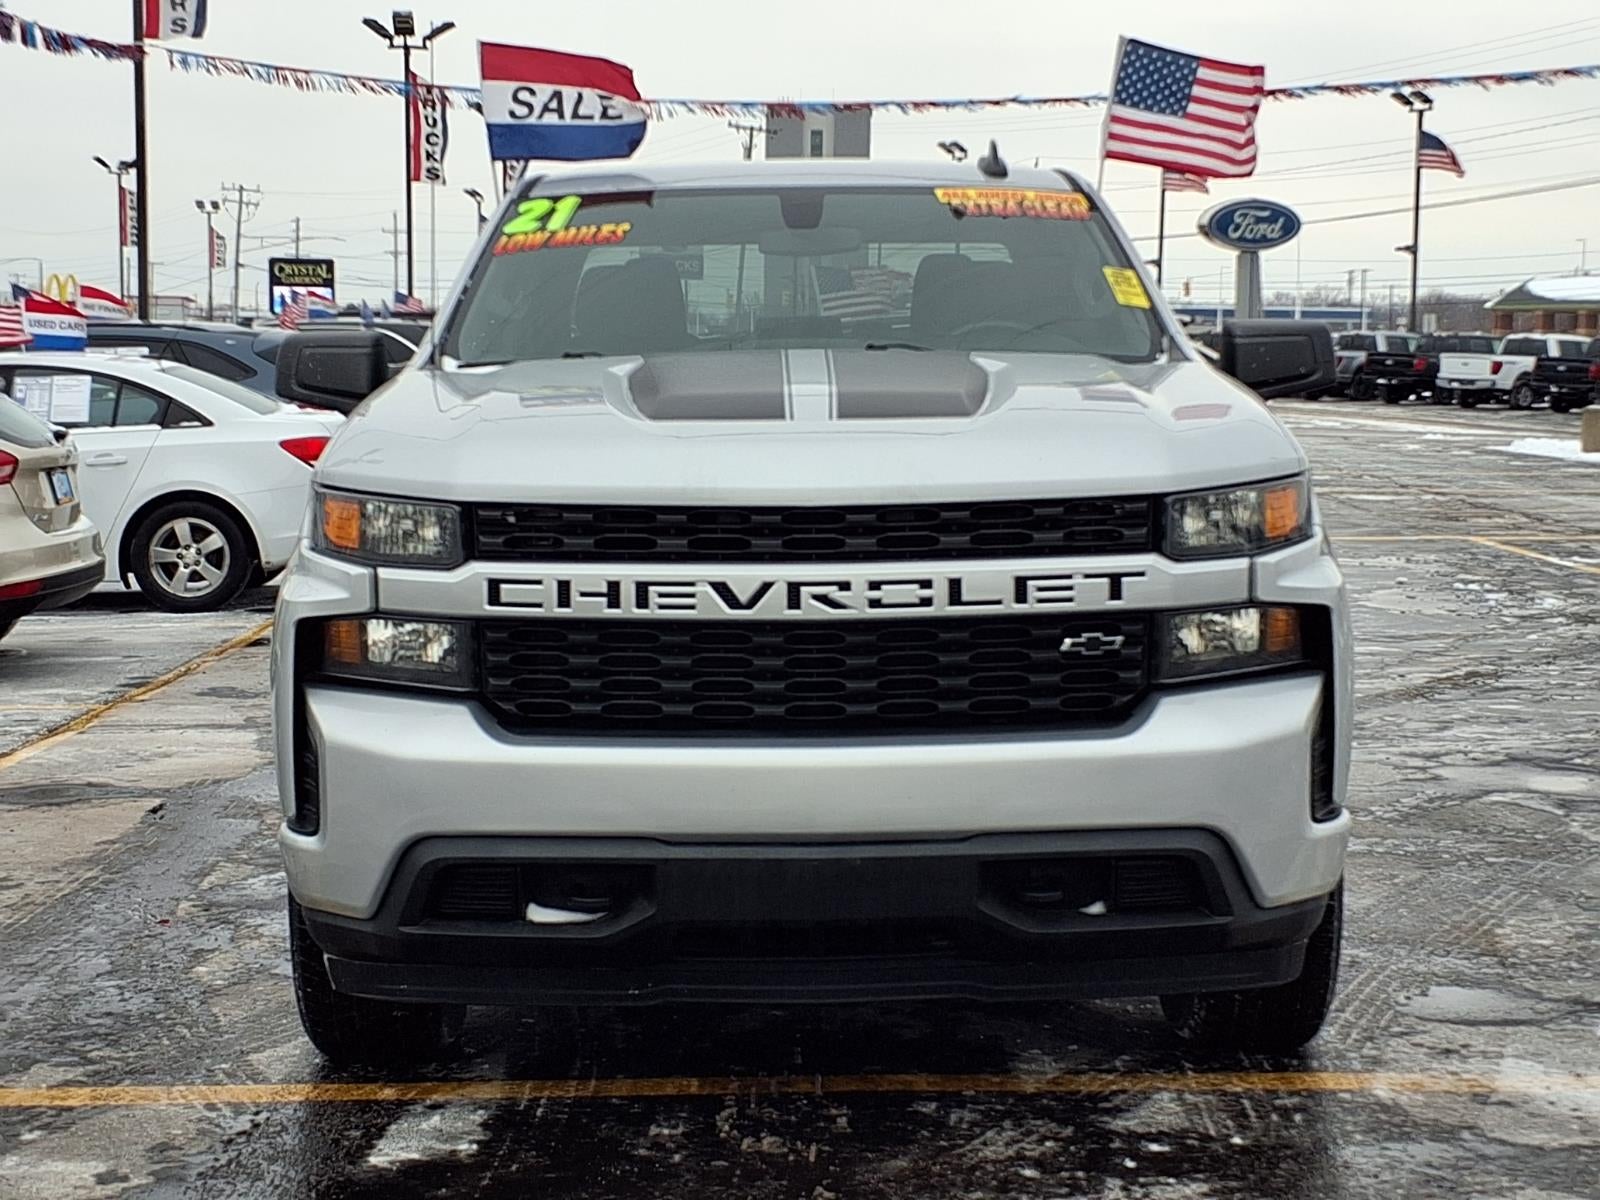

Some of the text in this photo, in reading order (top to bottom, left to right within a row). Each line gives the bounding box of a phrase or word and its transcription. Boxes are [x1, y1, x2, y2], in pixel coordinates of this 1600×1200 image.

[507, 86, 623, 121] SALE
[502, 195, 582, 234] 21
[1228, 208, 1285, 240] Ford
[493, 222, 632, 256] LOW MILES
[28, 318, 57, 330] USED
[485, 572, 1147, 612] CHEVROLET
